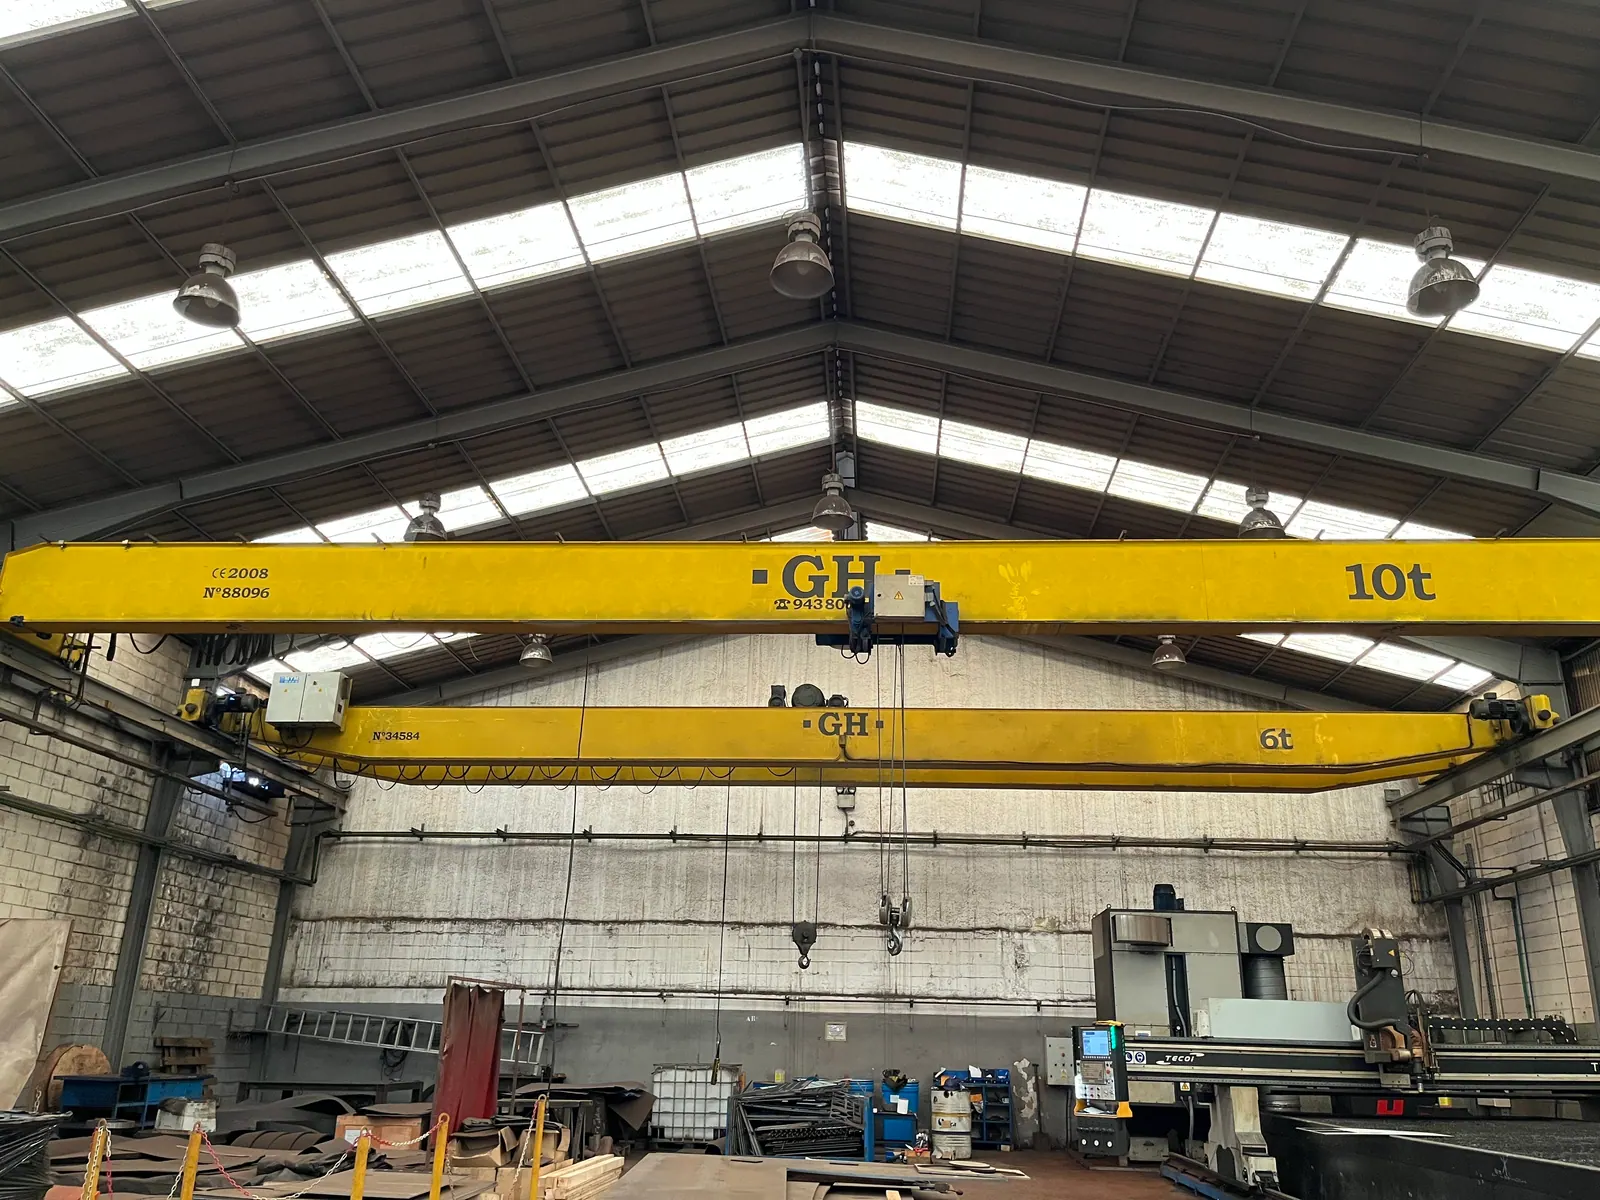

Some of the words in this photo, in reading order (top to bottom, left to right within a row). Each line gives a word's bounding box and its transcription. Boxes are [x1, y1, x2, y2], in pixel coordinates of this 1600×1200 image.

[782, 555, 881, 598] GH
[1346, 563, 1436, 600] 10t
[818, 712, 869, 736] GH
[1260, 728, 1293, 750] 6t
